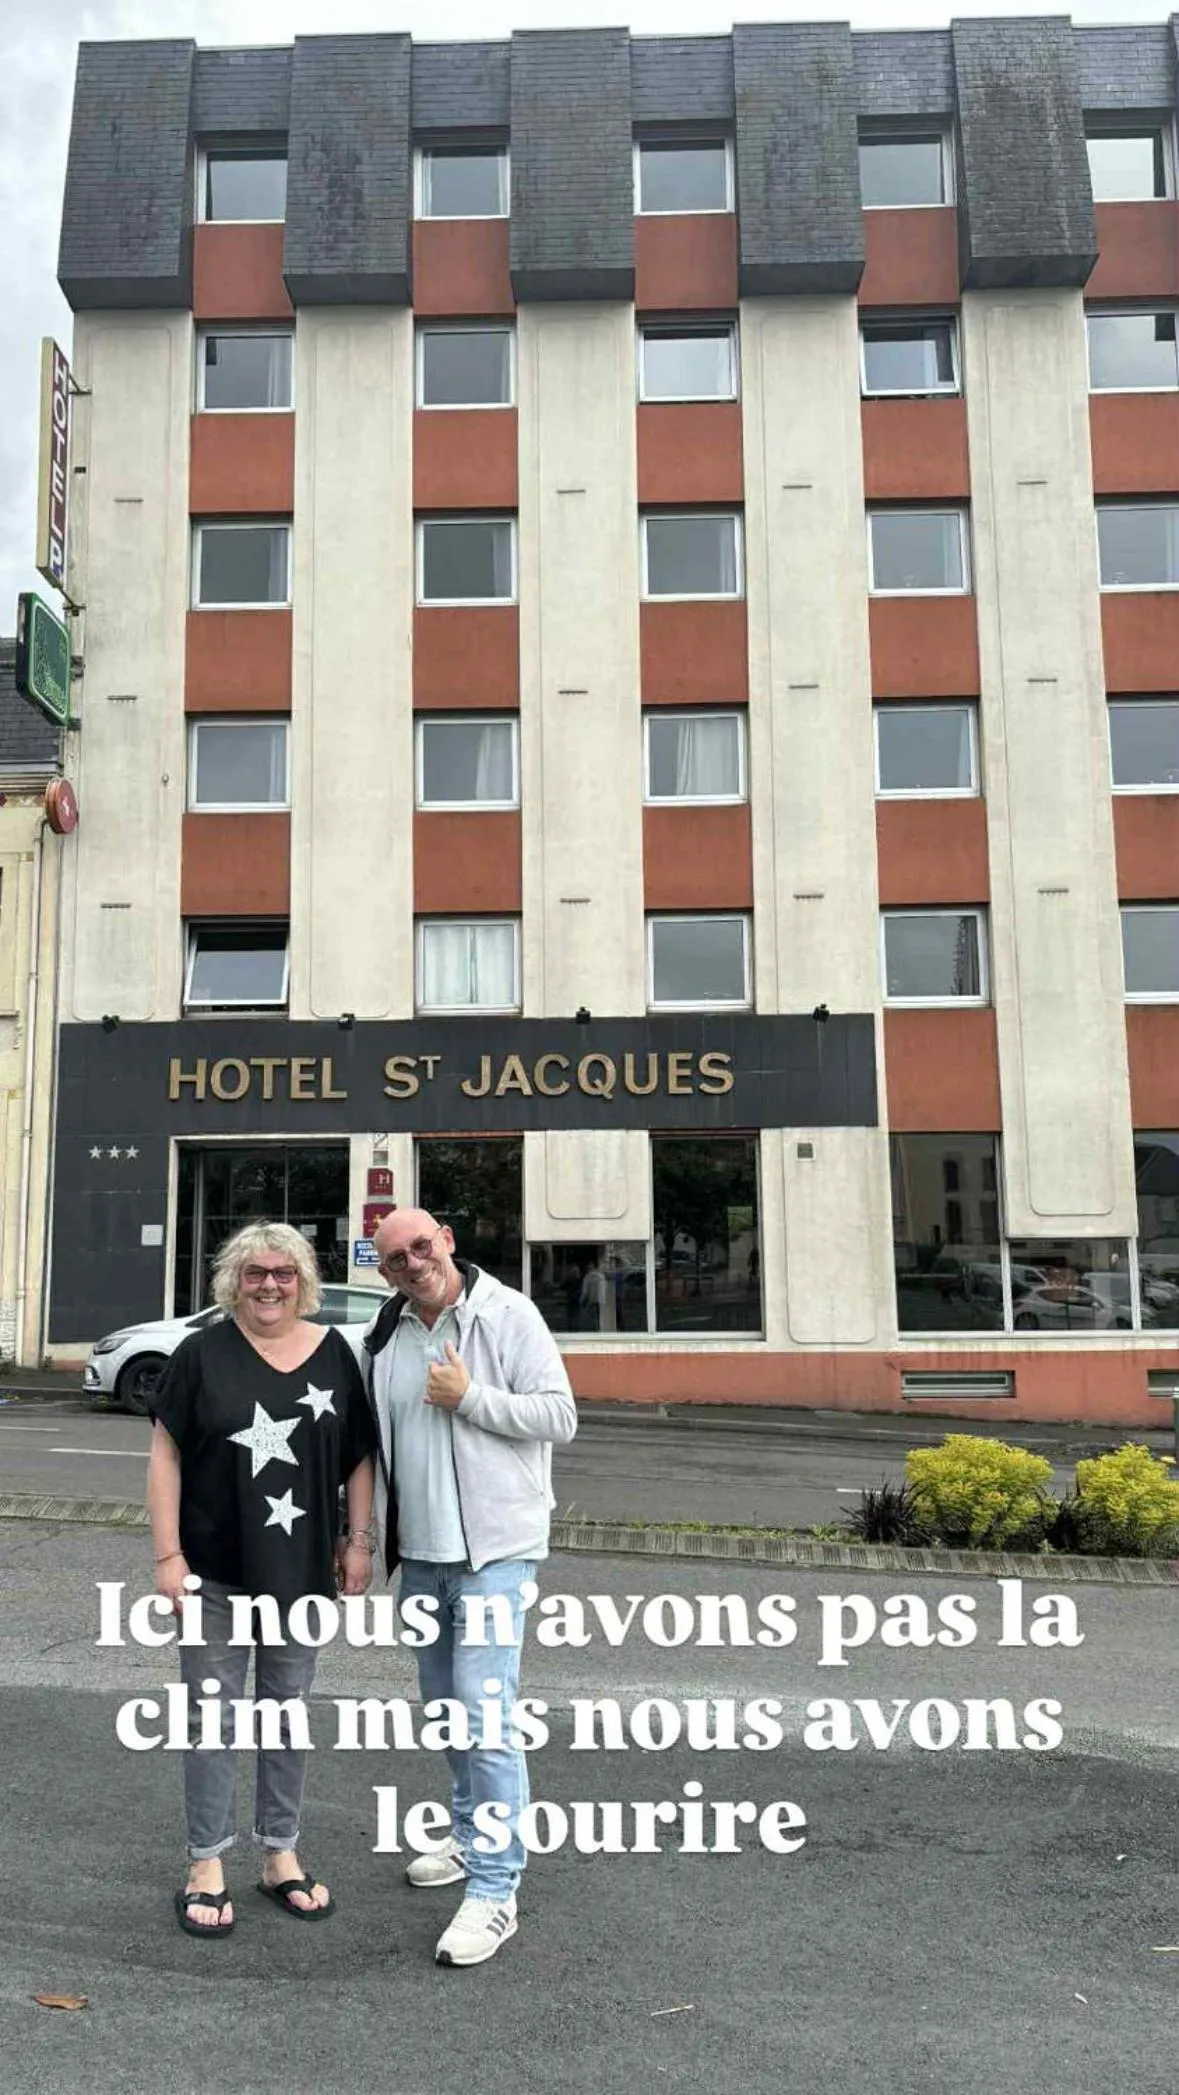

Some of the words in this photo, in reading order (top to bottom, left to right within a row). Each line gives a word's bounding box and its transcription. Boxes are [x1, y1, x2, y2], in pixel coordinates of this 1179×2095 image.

[51, 350, 67, 541] HOTEL
[168, 1056, 348, 1101] HOTEL
[460, 1052, 735, 1100] JACQUES
